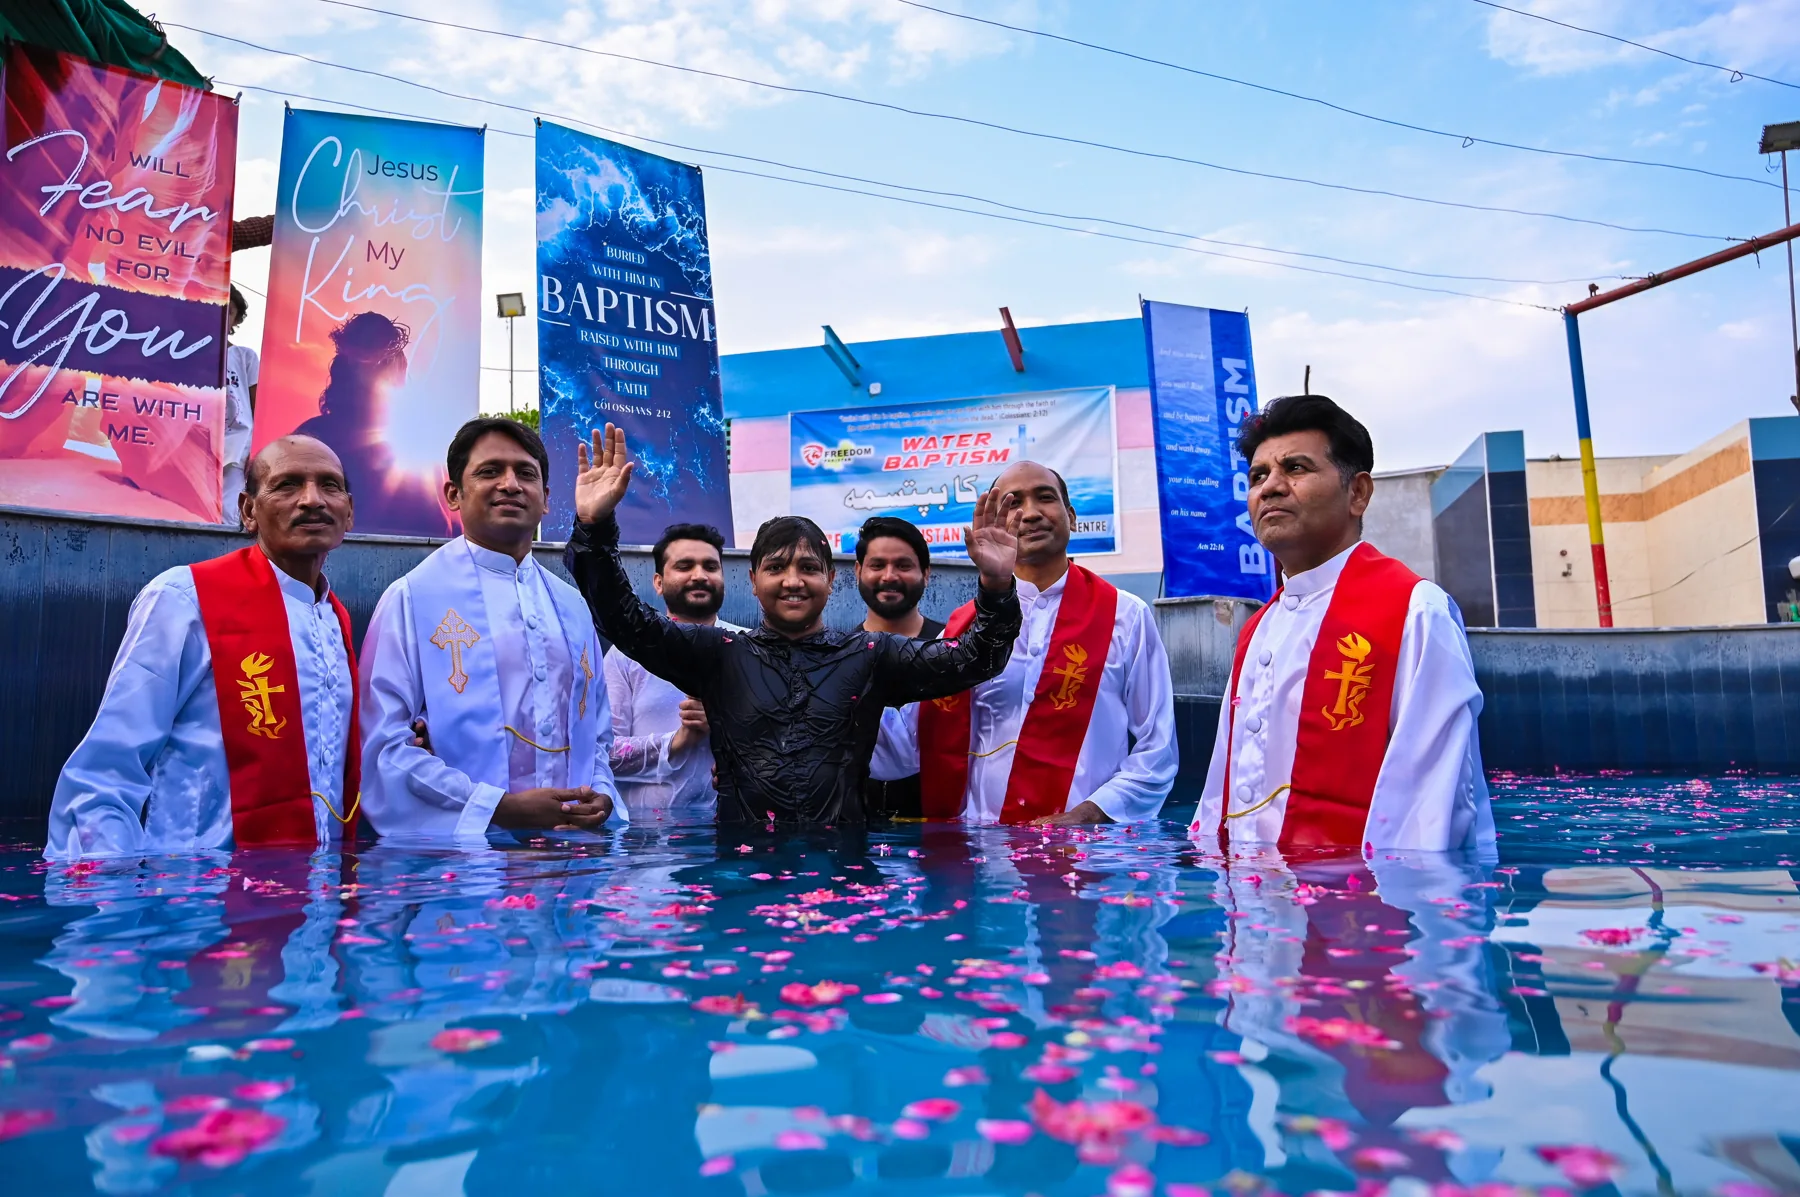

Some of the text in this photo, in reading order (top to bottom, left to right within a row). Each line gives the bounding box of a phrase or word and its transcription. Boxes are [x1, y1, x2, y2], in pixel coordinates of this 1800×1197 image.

[111, 147, 190, 178] I WILL
[367, 154, 439, 181] Jesus
[6, 129, 218, 233] Fear
[292, 136, 484, 242] Christ
[86, 223, 201, 263] NO EVIL,
[366, 240, 405, 270] My
[606, 246, 645, 264] BURIED
[116, 259, 170, 282] FOR
[592, 264, 661, 289] WITH HIM IN
[296, 235, 456, 385] King
[541, 274, 712, 342] BAPTISM
[0, 263, 213, 419] You
[580, 330, 678, 357] RAISED WITH HIM
[602, 356, 659, 376] THROUGH
[616, 381, 648, 396] FAITH
[61, 388, 202, 421] ARE WITH
[594, 400, 652, 416] COLOSSIANS
[107, 423, 155, 446] ME.
[903, 433, 992, 451] WATER
[825, 448, 872, 458] FREEDOM
[884, 448, 1010, 470] BAPTISM
[1180, 507, 1189, 517] his
[1077, 521, 1107, 532] ENTRE
